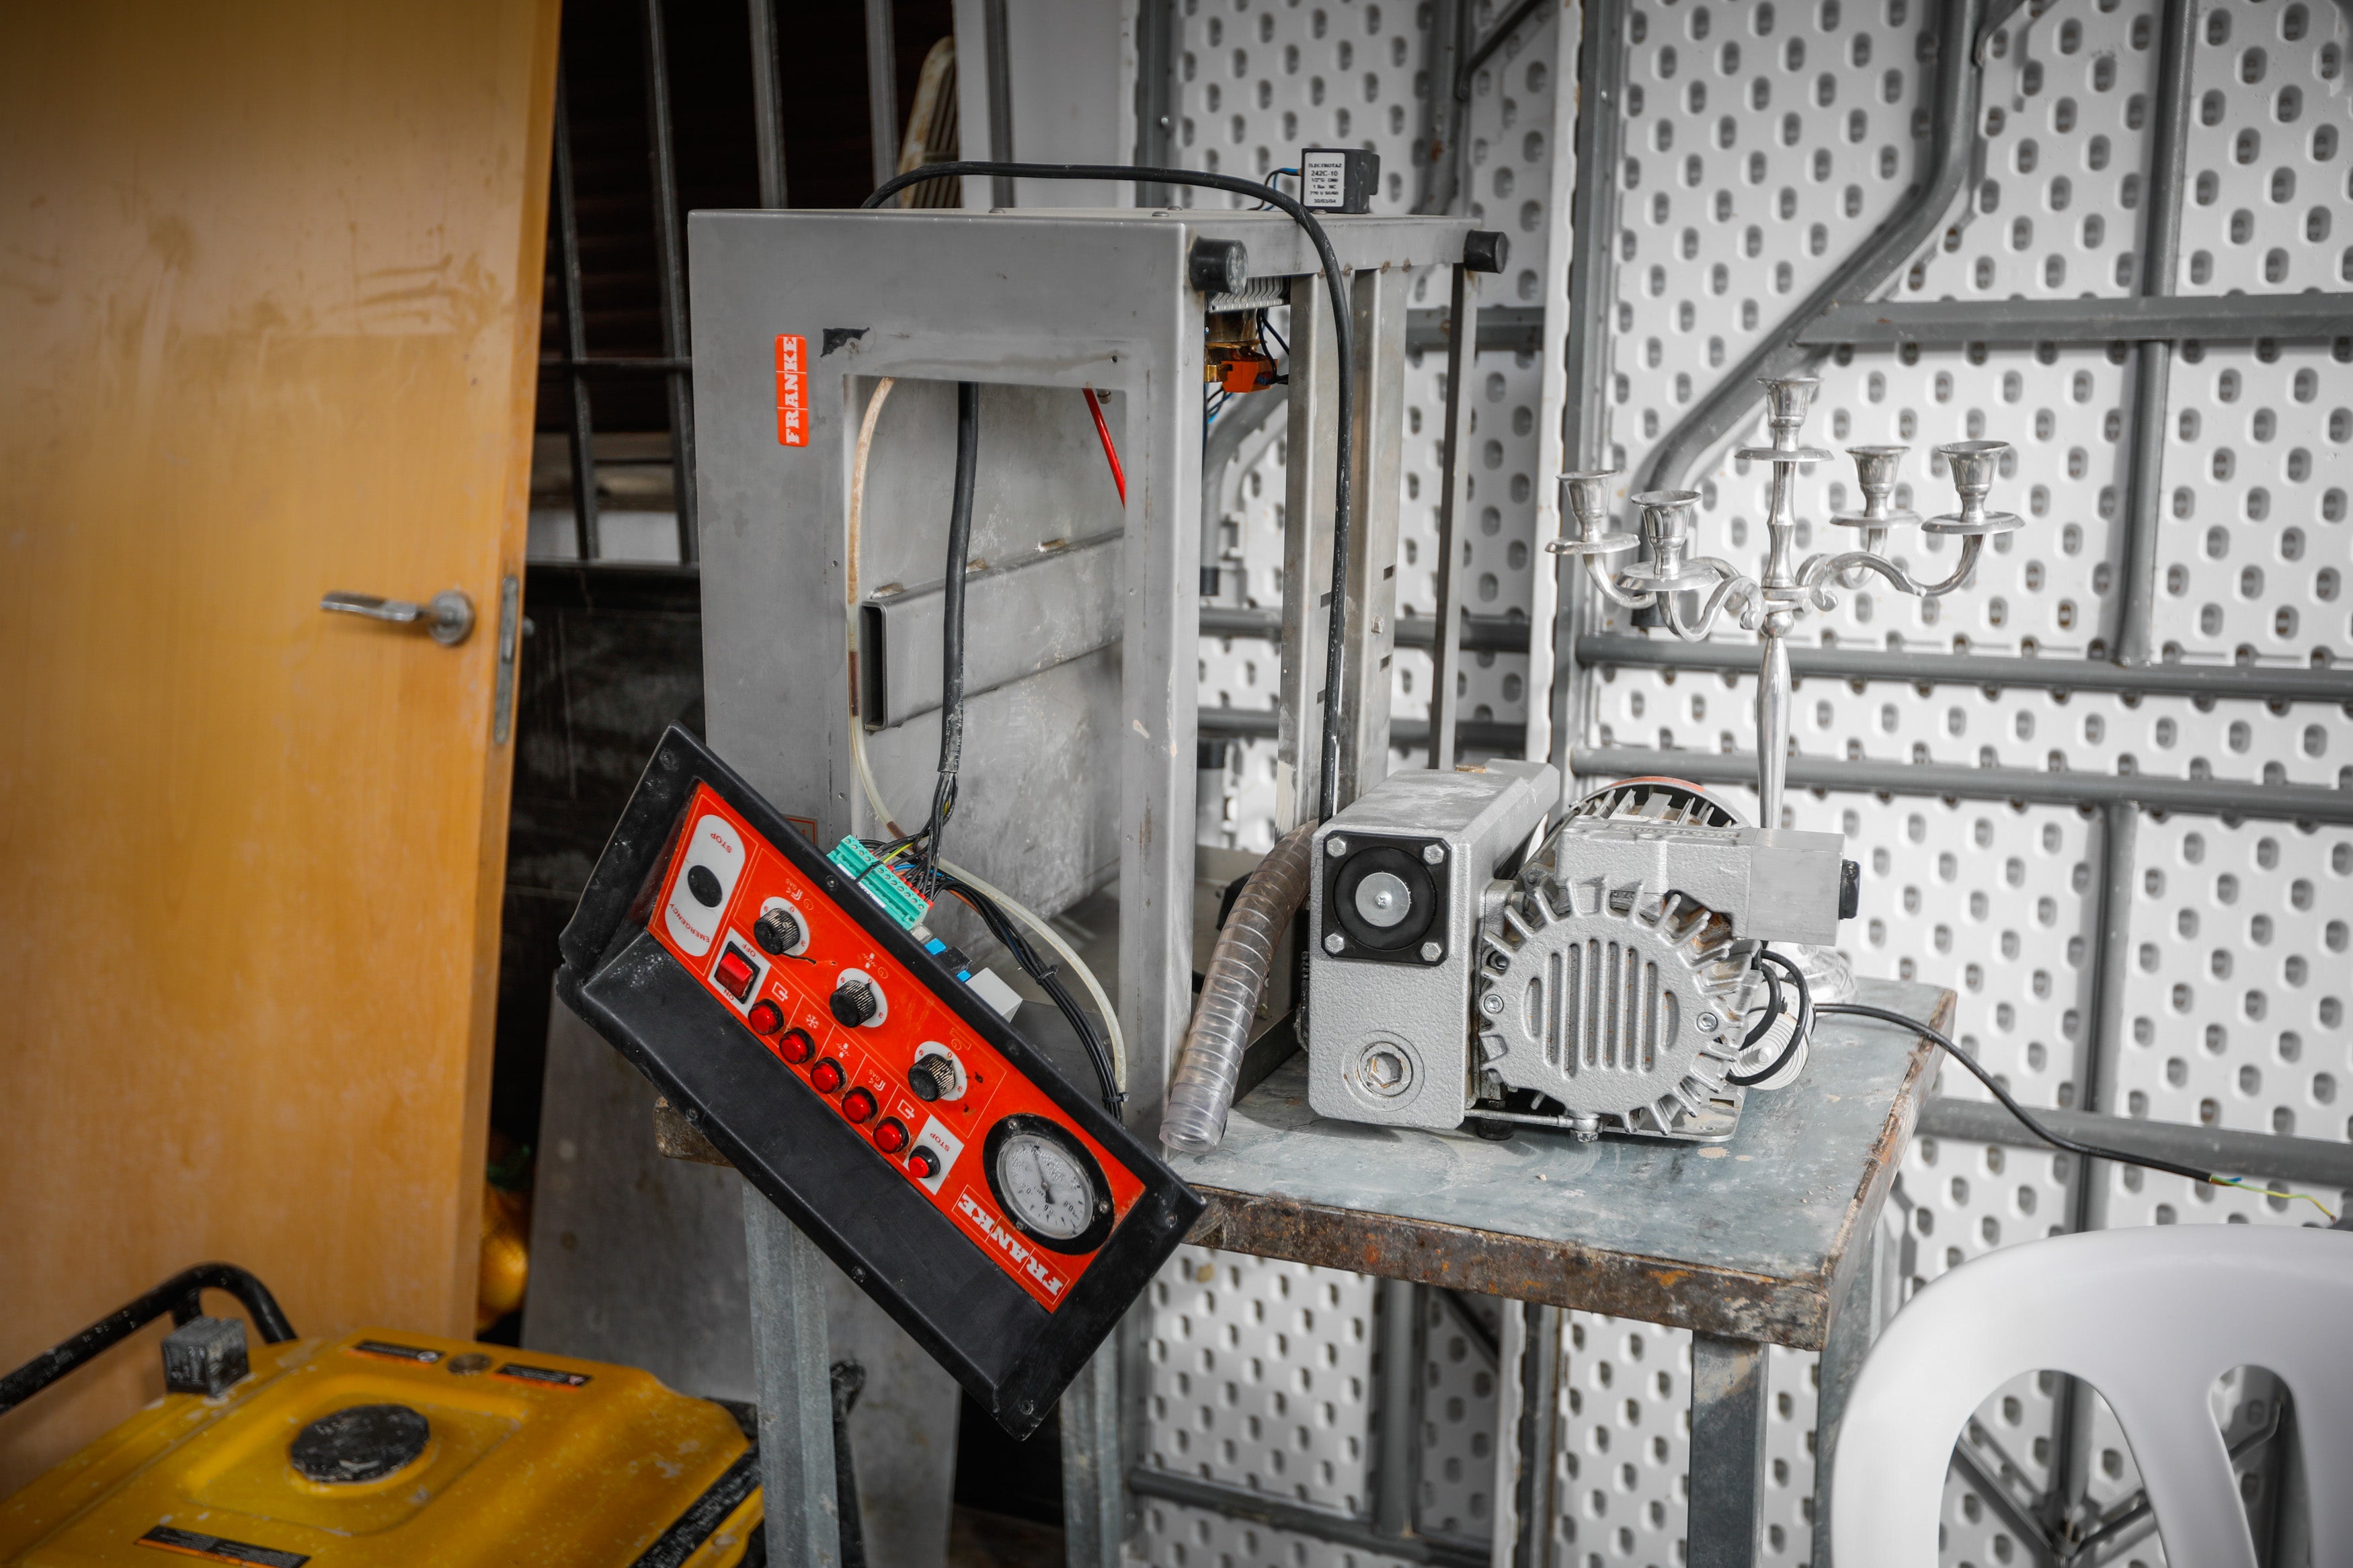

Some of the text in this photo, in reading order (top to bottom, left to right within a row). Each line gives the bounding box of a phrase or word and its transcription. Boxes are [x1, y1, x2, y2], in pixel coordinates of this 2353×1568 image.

[783, 336, 799, 444] FRANKE
[710, 832, 732, 854] STOP
[669, 903, 710, 943] EMERGENCY
[742, 943, 756, 957] OFF
[723, 989, 734, 1001] ON
[869, 1069, 880, 1081] GAS
[930, 1132, 950, 1152] STOP
[957, 1193, 1064, 1296] FRANKE
